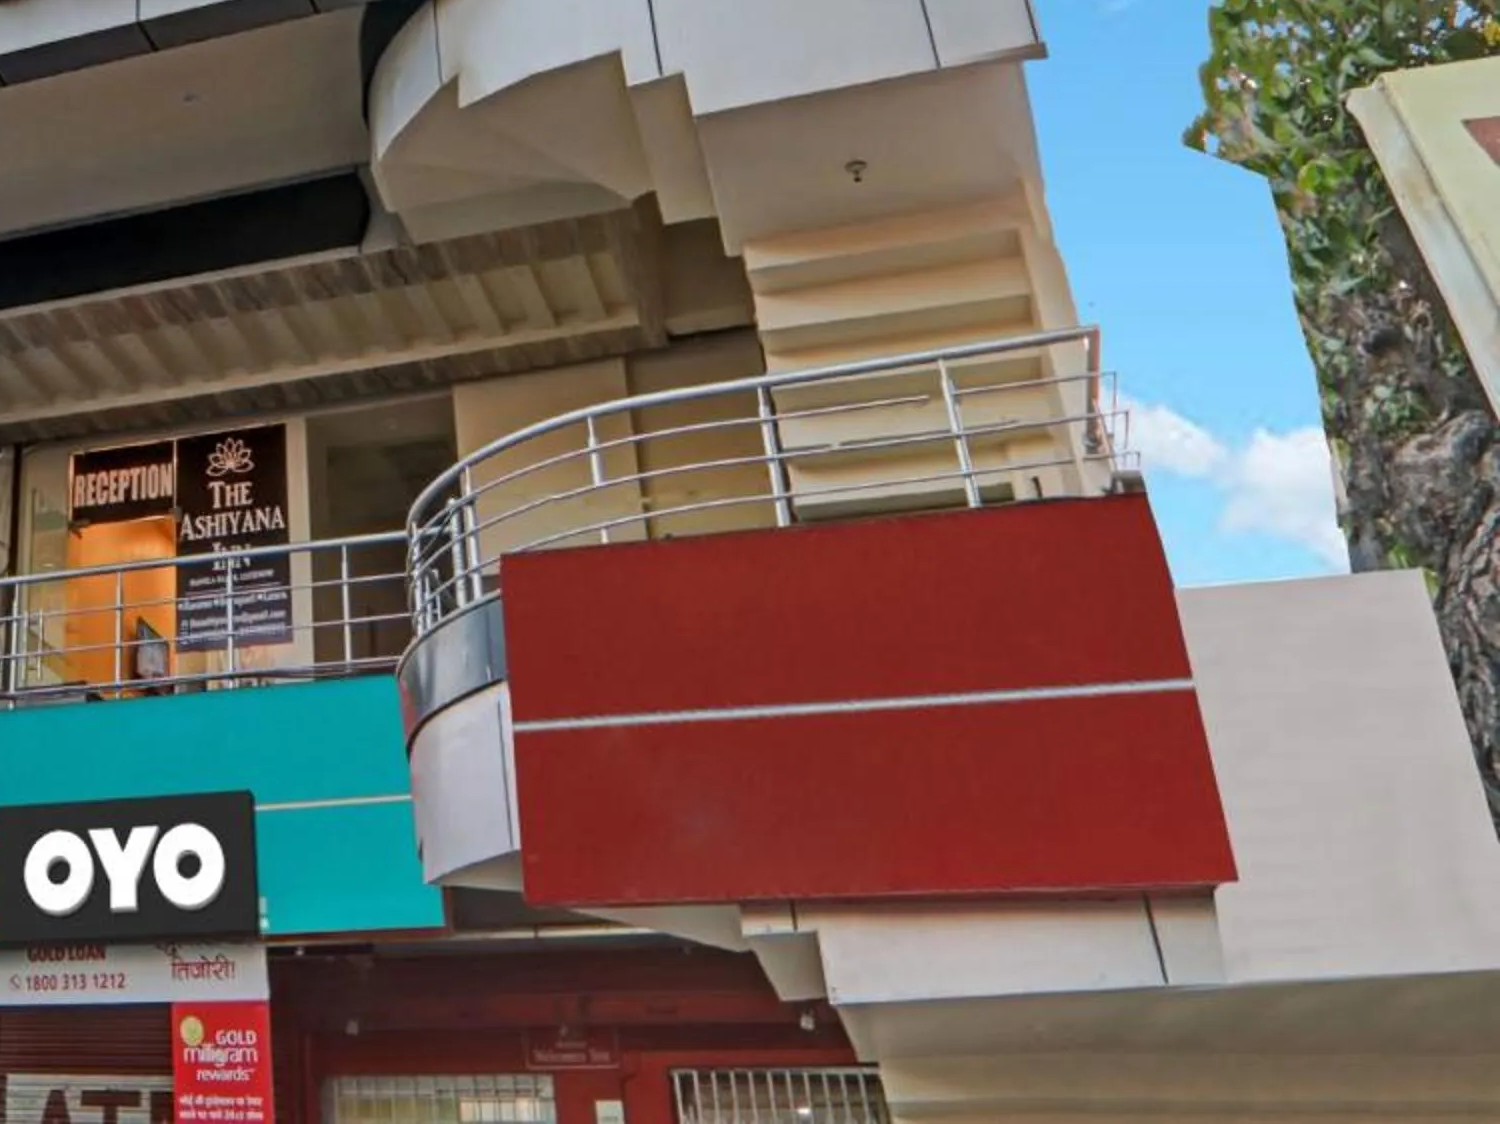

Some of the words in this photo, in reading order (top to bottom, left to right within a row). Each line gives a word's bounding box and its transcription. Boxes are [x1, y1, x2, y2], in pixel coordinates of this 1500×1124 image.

[73, 464, 174, 507] RECEPTION
[207, 480, 252, 509] THE
[180, 505, 285, 541] ASHIYANA
[24, 823, 225, 917] OYO
[26, 974, 58, 991] 1800
[62, 973, 87, 990] 313
[93, 972, 126, 989] 1212
[215, 1029, 257, 1045] GOLD
[196, 1067, 251, 1081] rewards
